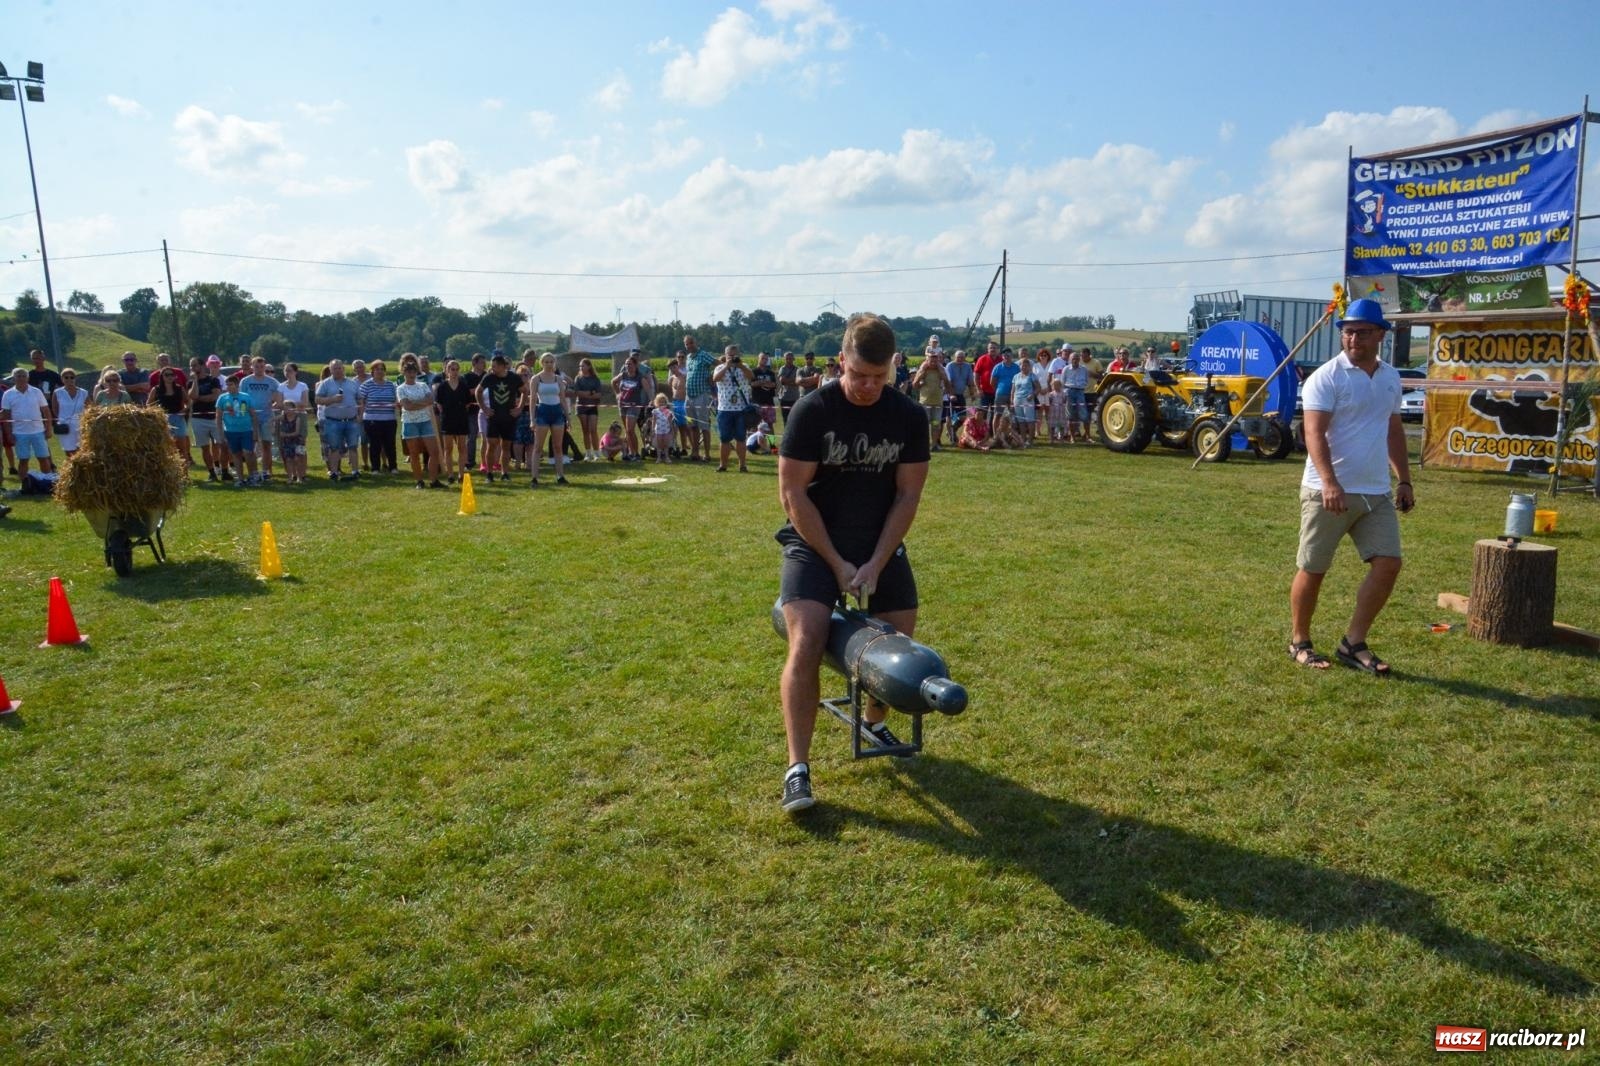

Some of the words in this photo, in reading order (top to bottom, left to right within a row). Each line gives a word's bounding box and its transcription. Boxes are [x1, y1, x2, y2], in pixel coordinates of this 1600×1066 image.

[1354, 157, 1463, 182] GERARD
[1467, 125, 1578, 168] FITZON
[1388, 200, 1454, 215] OCIEPLANIE
[1456, 190, 1523, 209] BUDYNKÓW
[1386, 213, 1453, 227] PRODUKCJA
[1456, 203, 1532, 221] SZTUKATERII
[1387, 227, 1419, 239] TYNKI
[1421, 220, 1501, 238] DEKORACYJNE
[1503, 216, 1530, 229] ZEW.
[1533, 215, 1537, 225] I
[1539, 210, 1570, 223] WEW.
[1353, 245, 1406, 259] Sławików
[1408, 242, 1422, 256] 32
[1425, 240, 1448, 255] 410
[1451, 239, 1467, 253] 63
[1470, 237, 1488, 253] 30,
[1491, 233, 1515, 249] 603
[1519, 230, 1541, 246] 703
[1545, 226, 1570, 242] 192
[1391, 252, 1523, 271] www.sztukateria-fitzon.pl
[1468, 292, 1484, 304] NR.
[1486, 291, 1492, 303] 1
[1200, 360, 1226, 372] studio
